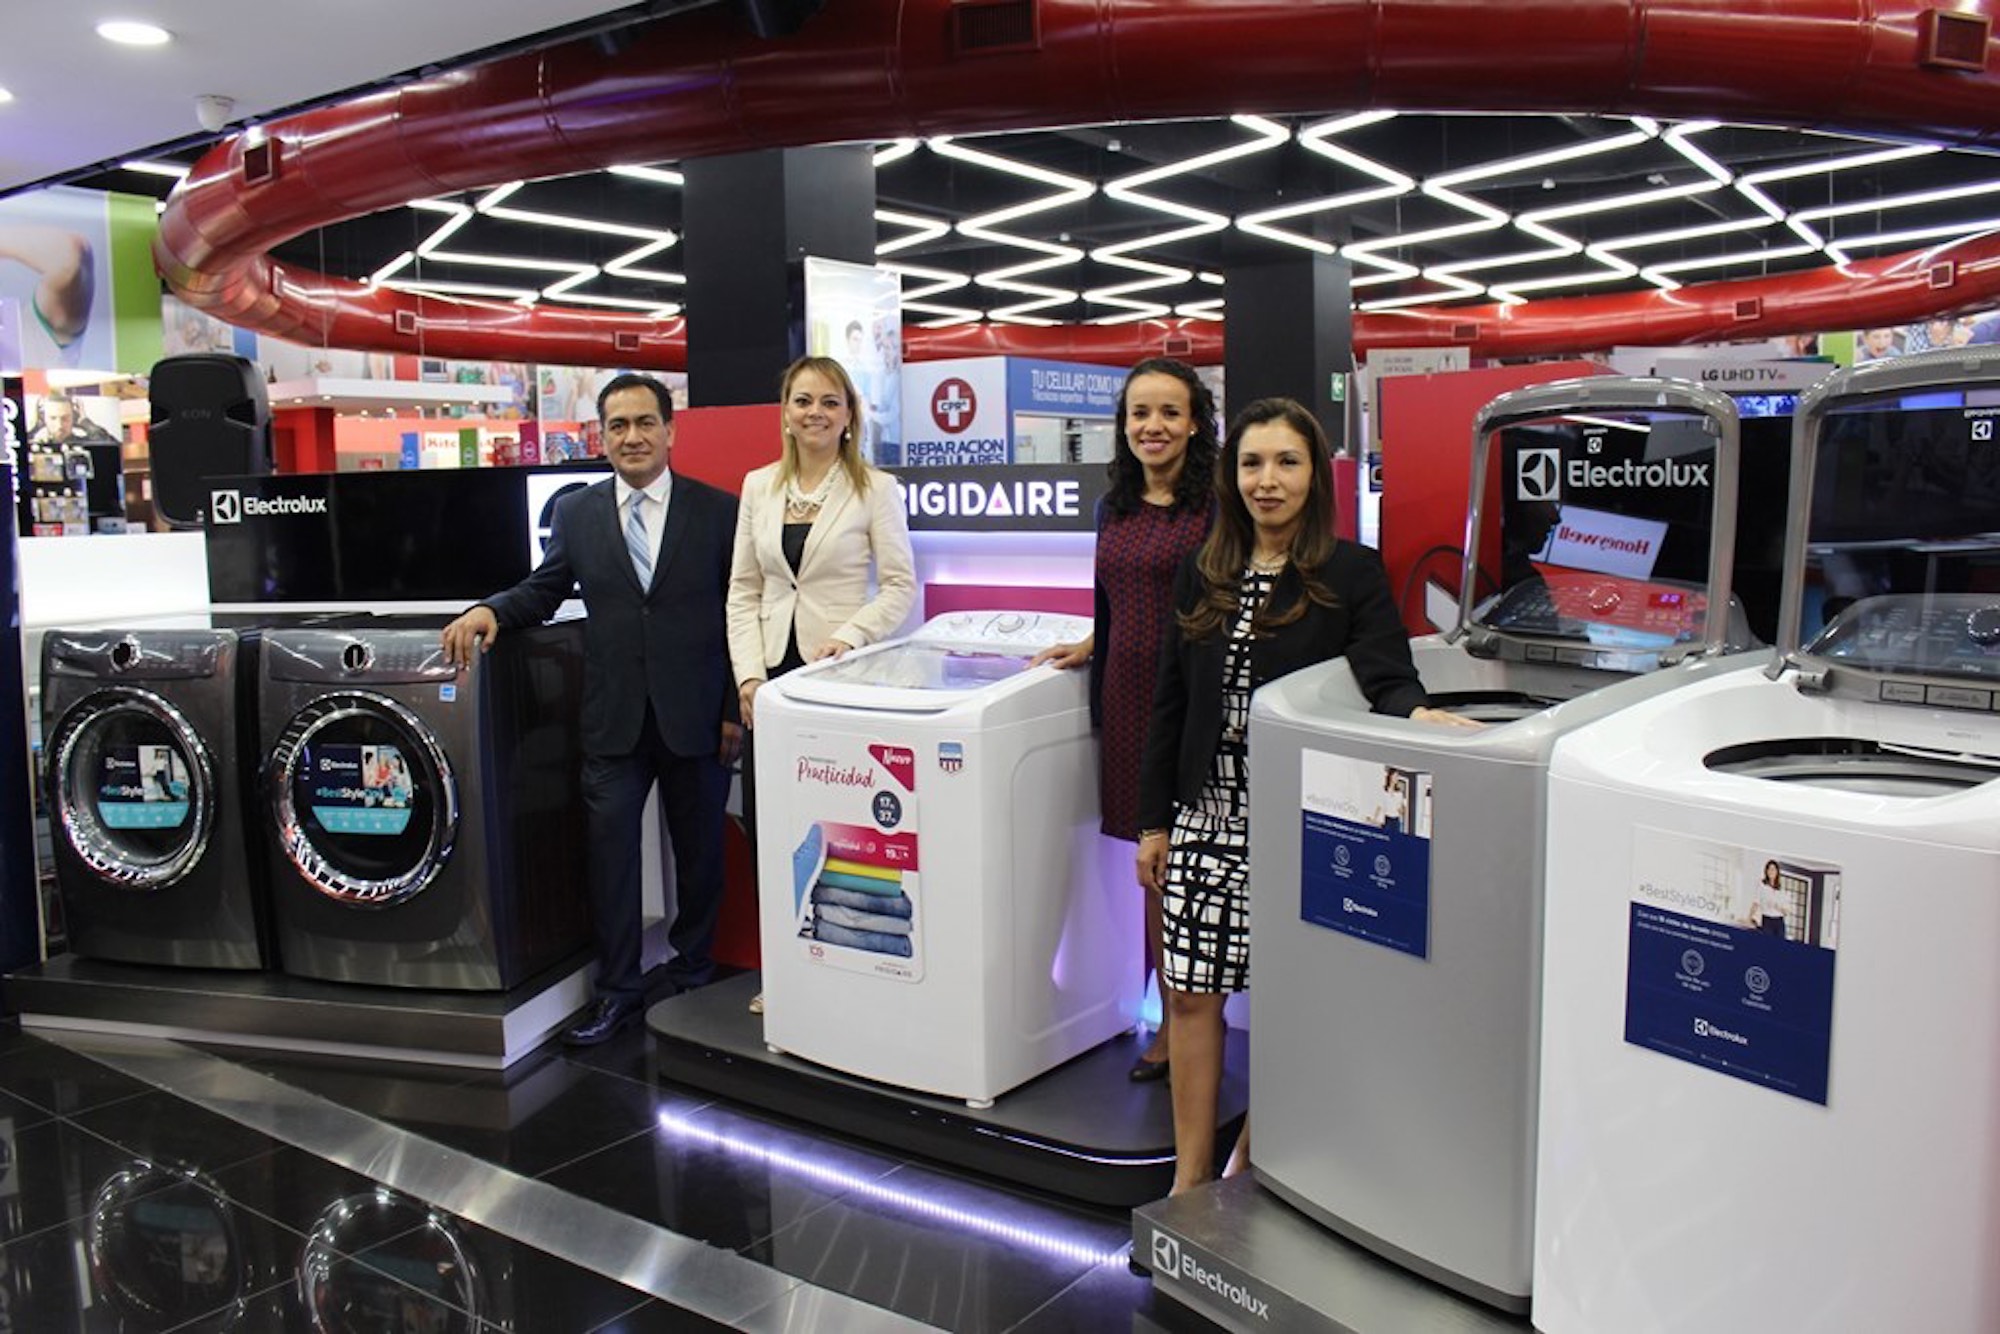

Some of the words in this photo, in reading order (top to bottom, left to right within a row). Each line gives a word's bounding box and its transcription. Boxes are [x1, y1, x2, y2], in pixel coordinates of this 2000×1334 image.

[1045, 371, 1085, 392] CELULAR
[1087, 374, 1111, 393] COMO
[1701, 369, 1719, 381] LG
[1722, 369, 1754, 380] UHD
[1759, 368, 1778, 380] TV
[1567, 458, 1710, 488] Electrolux
[243, 496, 327, 515] Electrolux
[797, 755, 876, 788] Practicidad
[1640, 884, 1720, 915] #BestStyleDay
[1708, 1024, 1748, 1046] Electrolux
[1181, 1253, 1269, 1321] Electrolux
